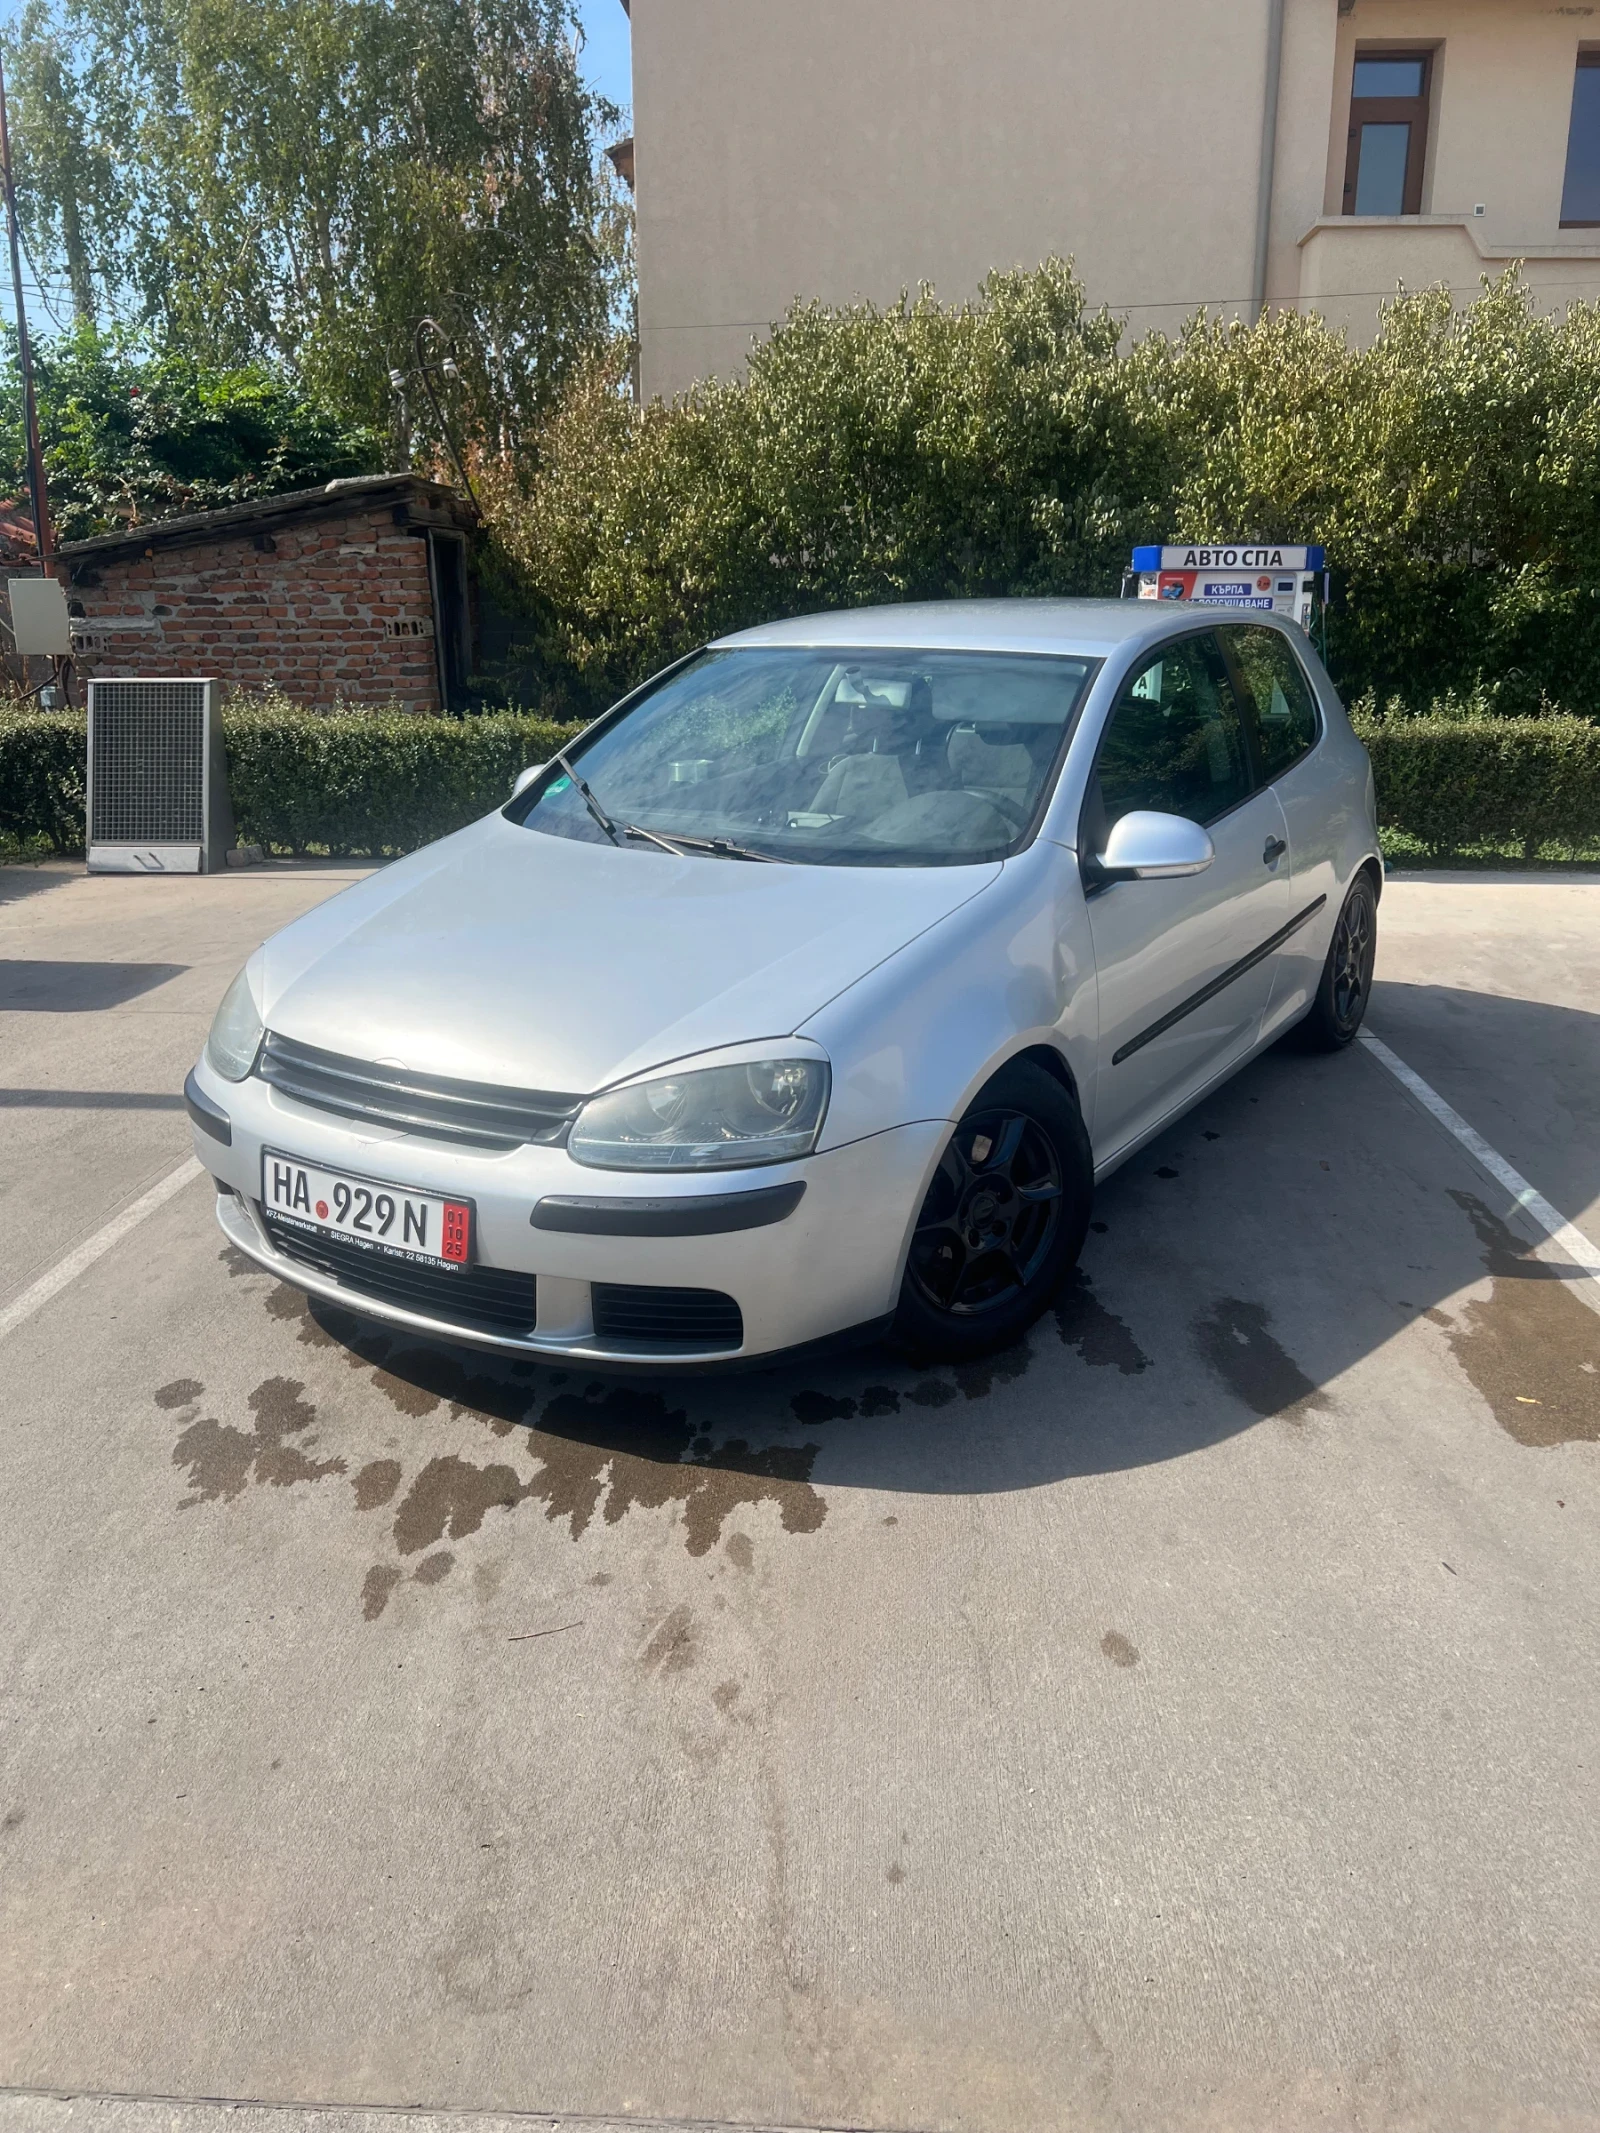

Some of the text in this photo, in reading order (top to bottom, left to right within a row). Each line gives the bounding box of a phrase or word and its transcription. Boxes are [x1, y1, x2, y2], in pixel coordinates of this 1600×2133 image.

[1184, 550, 1283, 567] АВТО СПА
[1211, 585, 1244, 595] КЪРПА
[274, 1161, 310, 1214] HA
[447, 1209, 463, 1225] 01
[448, 1224, 463, 1241] 10
[330, 1231, 354, 1244] SIEGRA
[354, 1238, 374, 1250] Hagen
[406, 1252, 415, 1260] 22
[437, 1259, 459, 1271] Hagen
[446, 1241, 462, 1256] 25
